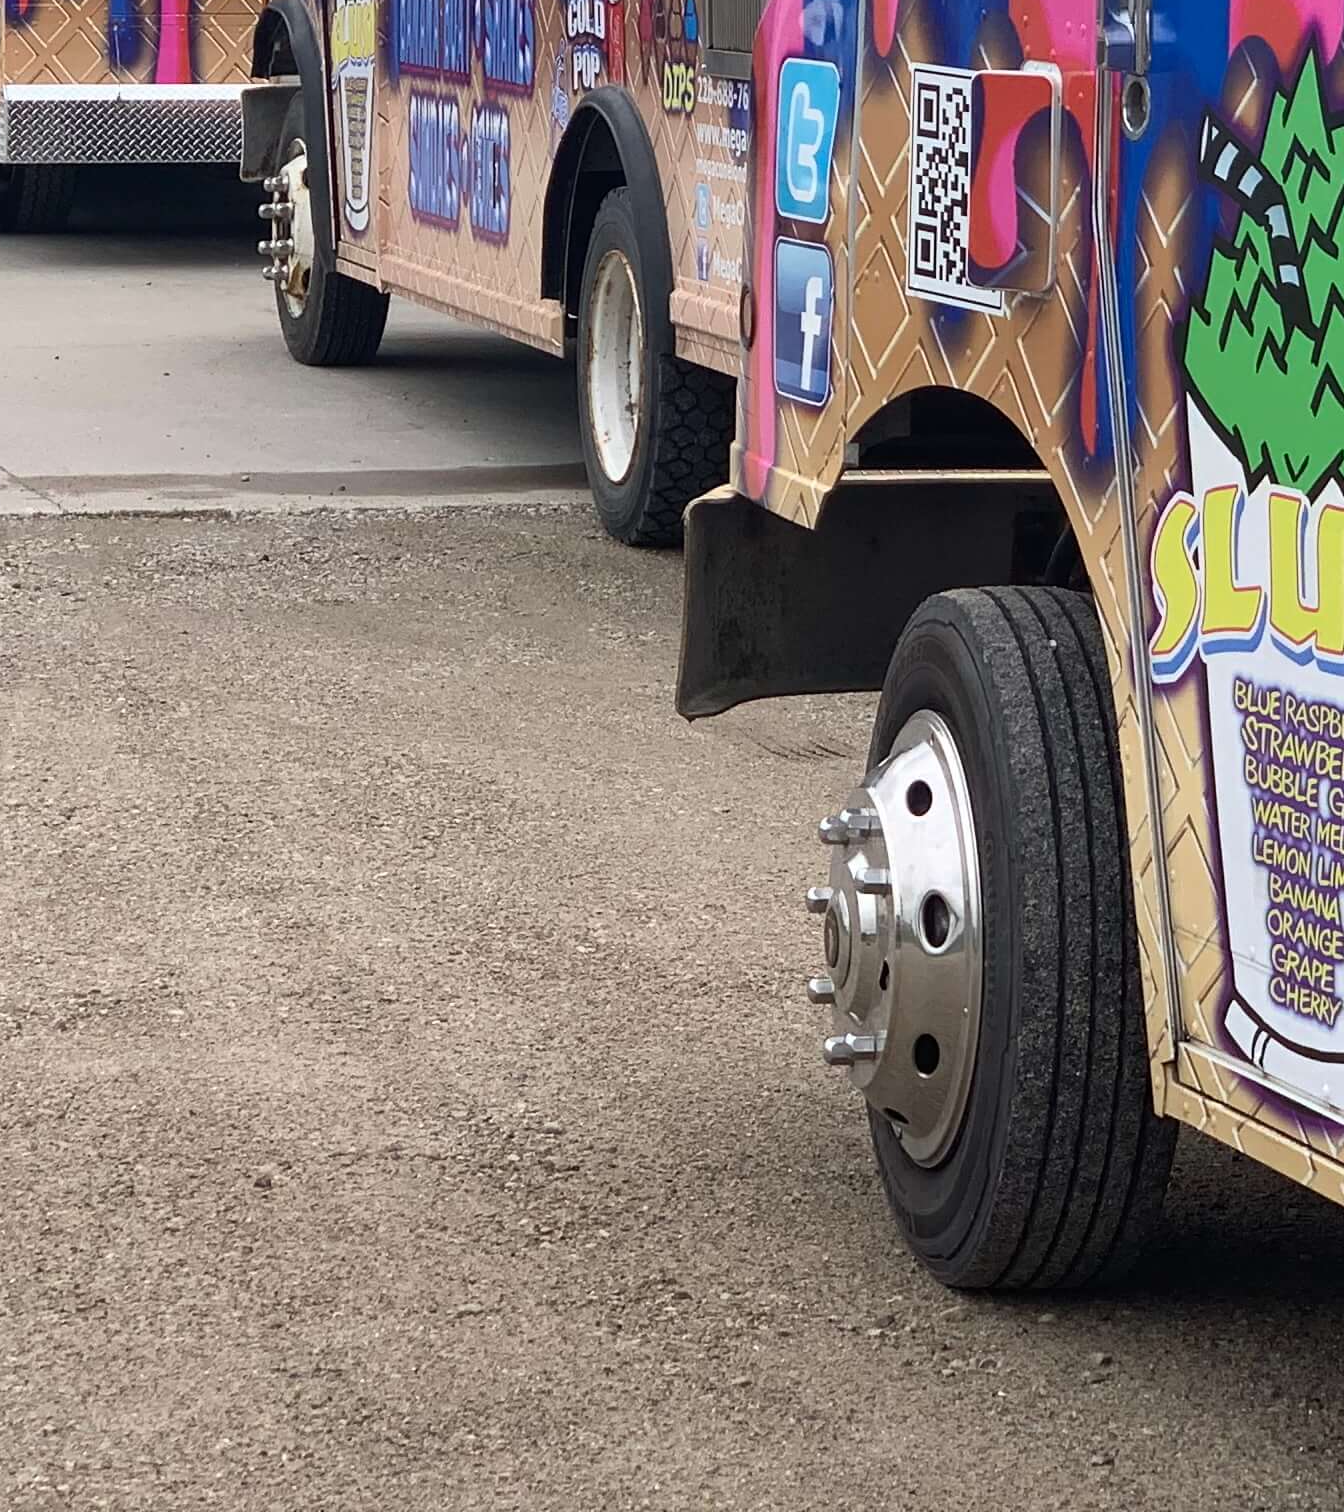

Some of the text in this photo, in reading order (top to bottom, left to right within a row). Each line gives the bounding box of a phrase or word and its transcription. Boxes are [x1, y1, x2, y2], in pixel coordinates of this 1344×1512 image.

[573, 42, 601, 91] POP
[663, 61, 695, 114] DIPS
[697, 76, 750, 111] 226-688-76
[696, 123, 748, 156] www.mega
[1233, 679, 1281, 721] BLUE
[1243, 755, 1318, 809] BUBBLE
[1251, 795, 1312, 843] WATER
[1252, 833, 1312, 886] LEMON
[1269, 875, 1341, 928] BANANA
[1270, 941, 1335, 994] GRAPE
[1269, 976, 1342, 1027] CHERRY
